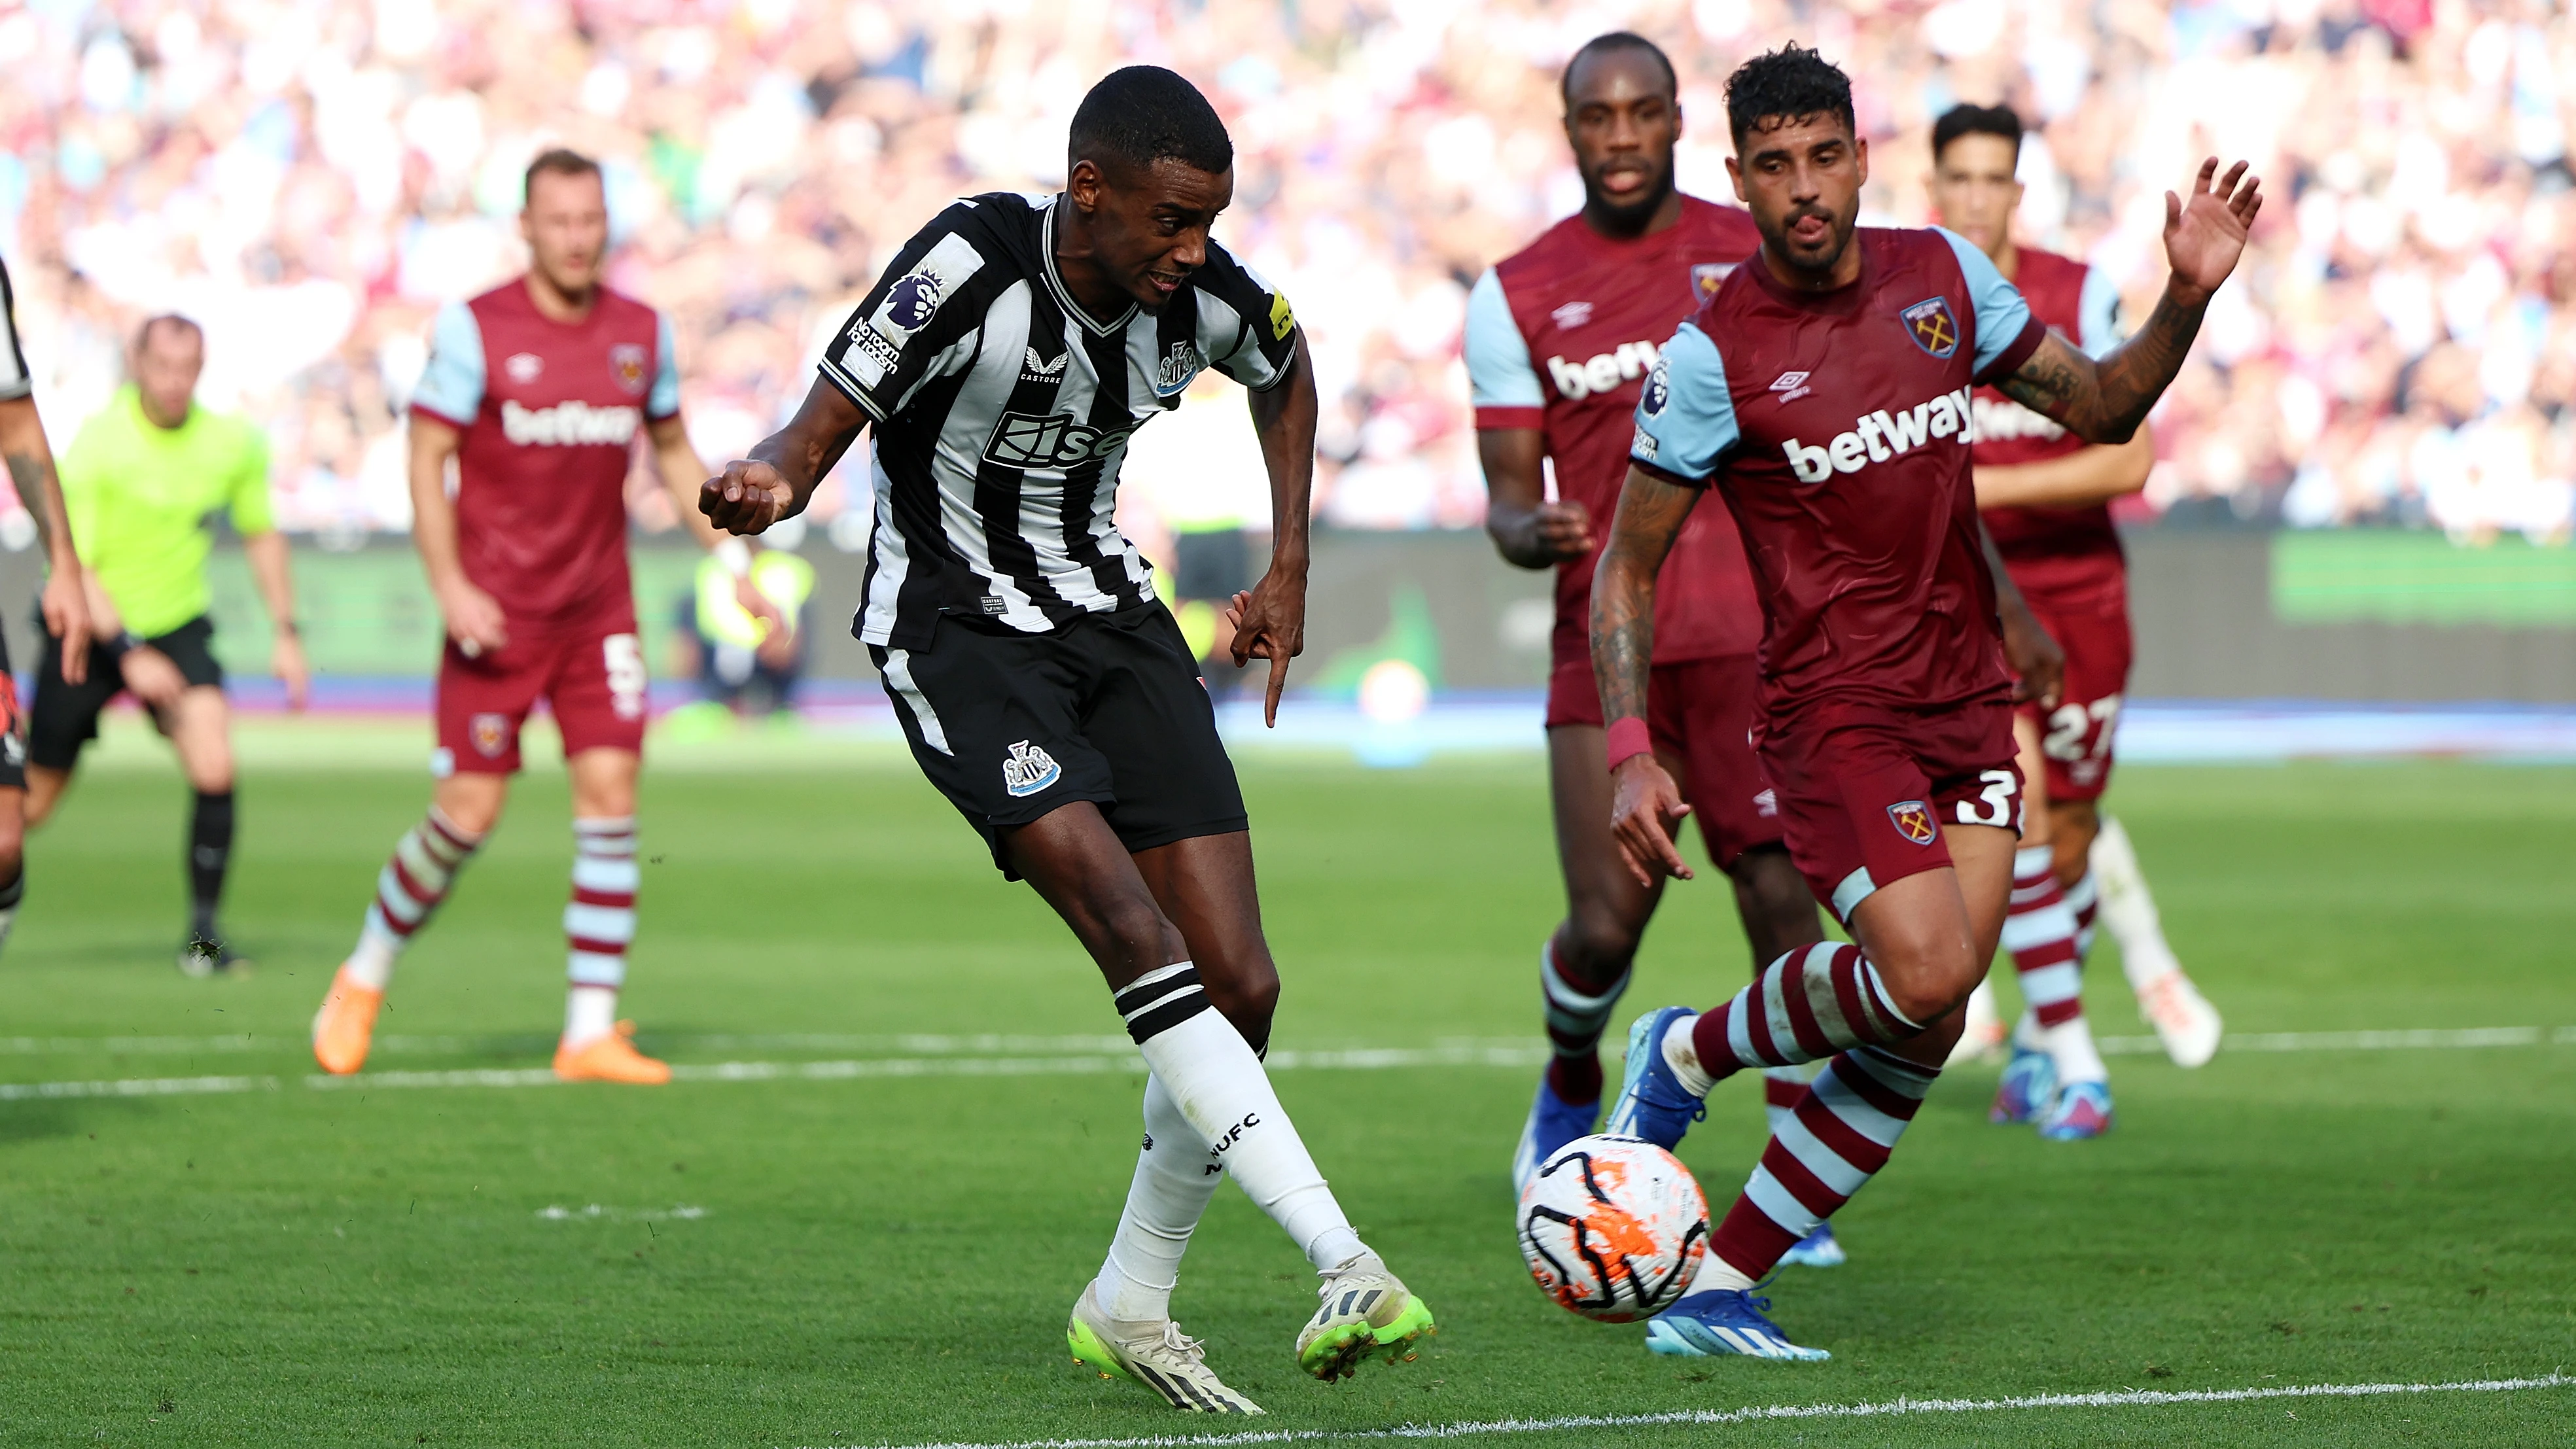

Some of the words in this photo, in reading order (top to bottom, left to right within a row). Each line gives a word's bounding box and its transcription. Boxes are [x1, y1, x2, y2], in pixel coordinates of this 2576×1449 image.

[853, 316, 871, 336] No
[868, 332, 900, 362] room
[860, 340, 898, 375] racism
[1021, 374, 1061, 384] CASTORE
[1778, 385, 1812, 404] umbro
[1781, 383, 1973, 483] betway
[603, 632, 648, 693] 5
[2042, 693, 2120, 761] 27
[1956, 769, 2026, 837] 3
[1209, 1112, 1261, 1160] NUFC
